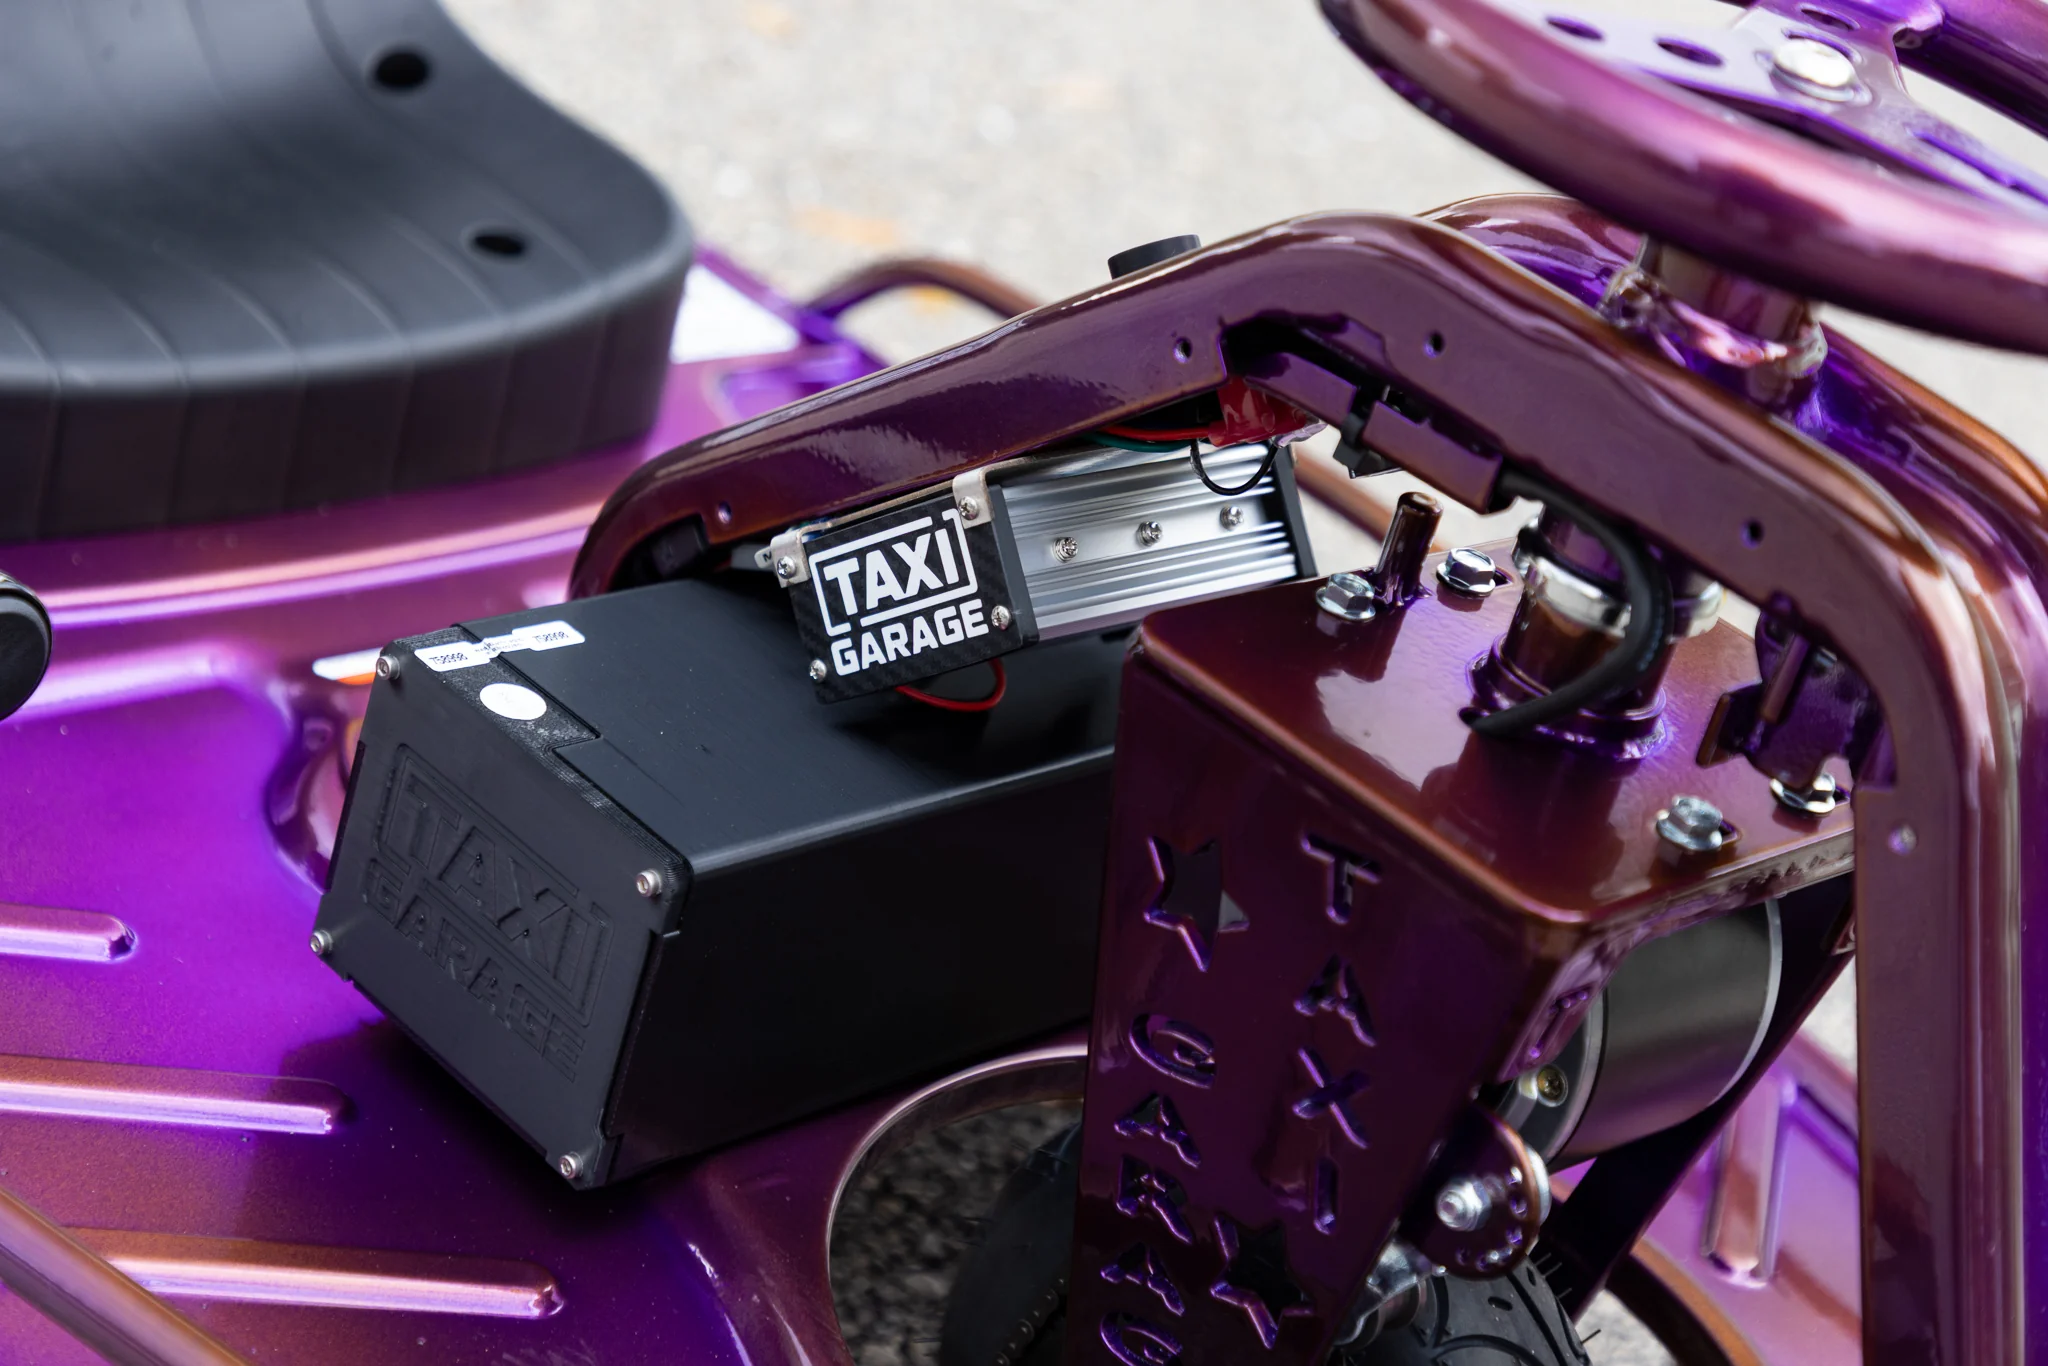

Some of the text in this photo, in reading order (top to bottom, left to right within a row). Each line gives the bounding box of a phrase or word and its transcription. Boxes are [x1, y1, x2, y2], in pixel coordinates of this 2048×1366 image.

[823, 528, 960, 616] TAXI
[830, 598, 989, 677] GARAGE
[361, 856, 586, 1084] GARAGE
[403, 772, 592, 993] TAXI
[1292, 832, 1381, 1236] TAXI
